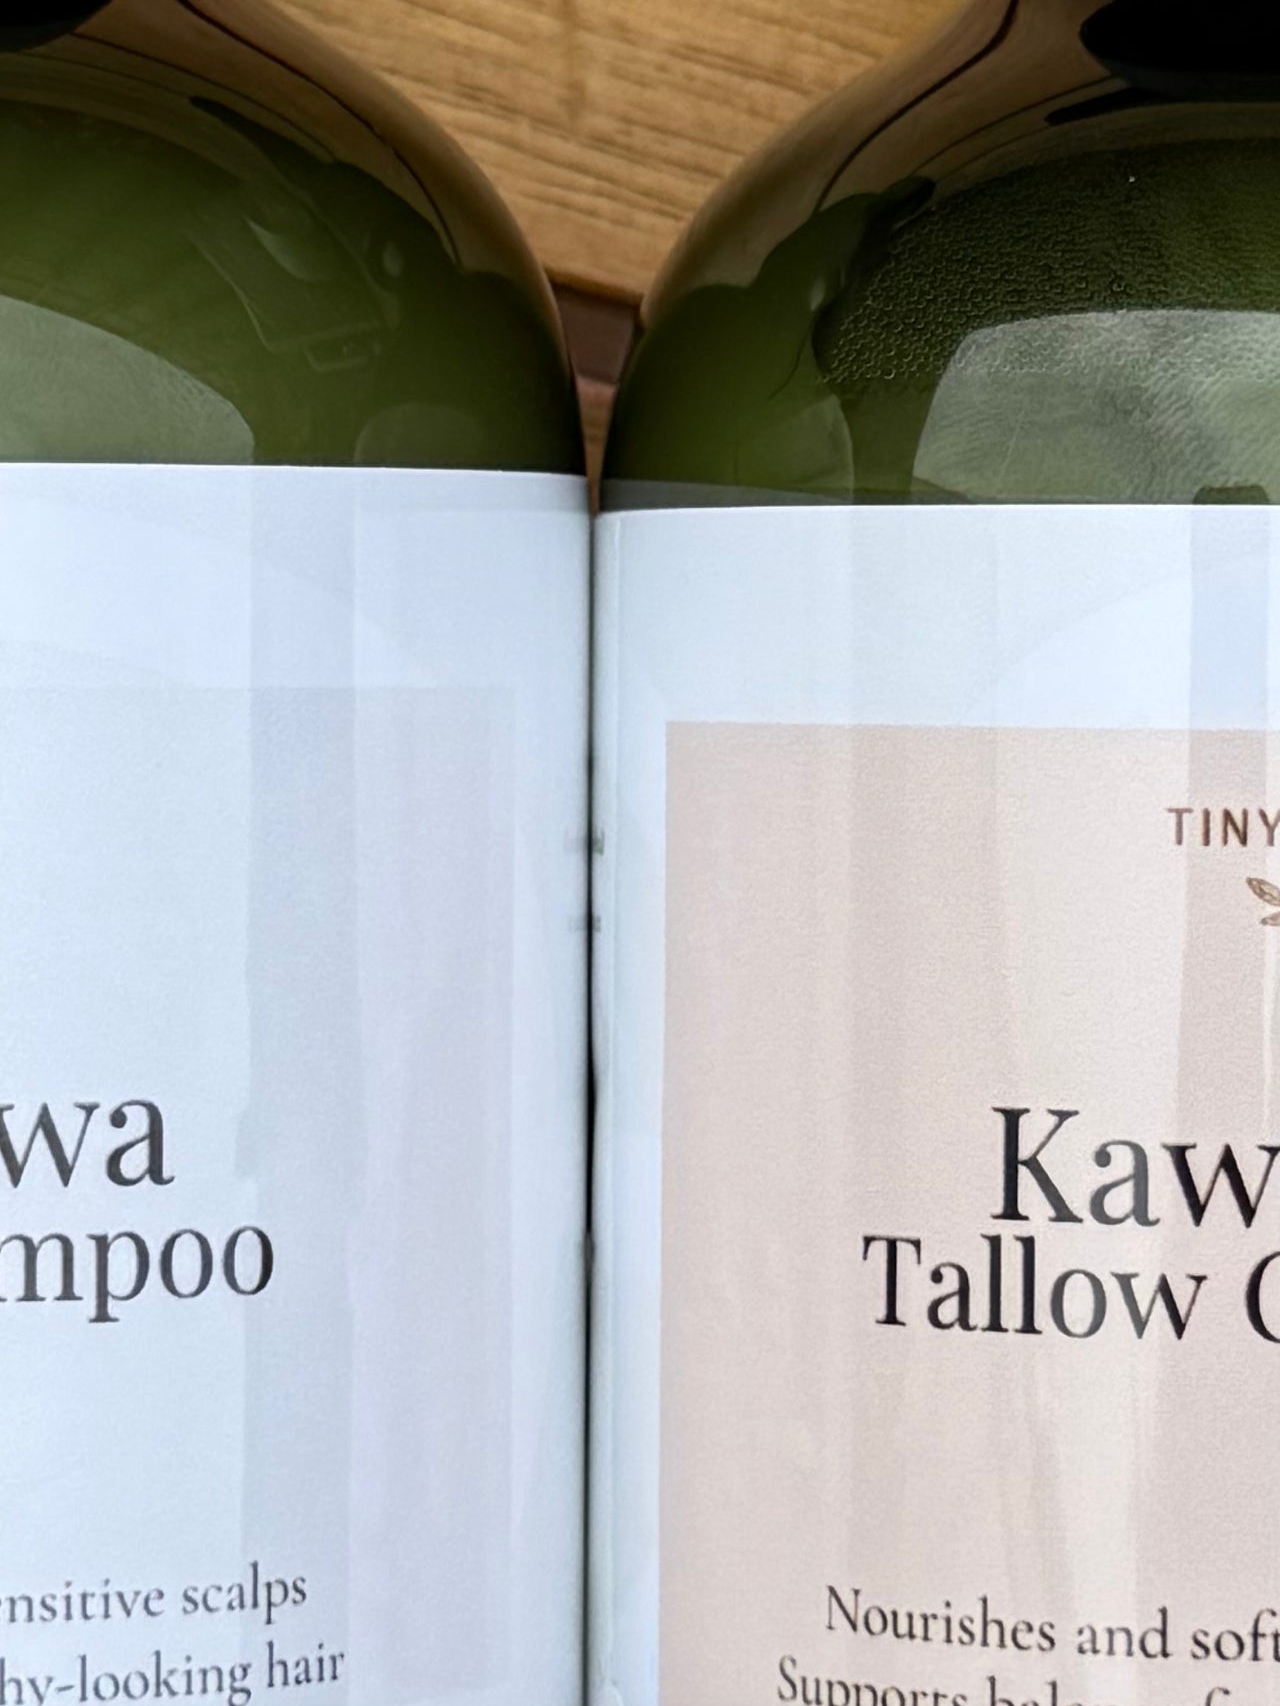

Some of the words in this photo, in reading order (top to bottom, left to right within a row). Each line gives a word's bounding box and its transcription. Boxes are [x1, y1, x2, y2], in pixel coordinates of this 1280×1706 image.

[861, 1232, 1209, 1342] Tallow
[181, 1559, 308, 1623] scalps
[825, 1584, 1057, 1653] Nourishes
[1076, 1605, 1173, 1660] and
[265, 1638, 346, 1690] hair
